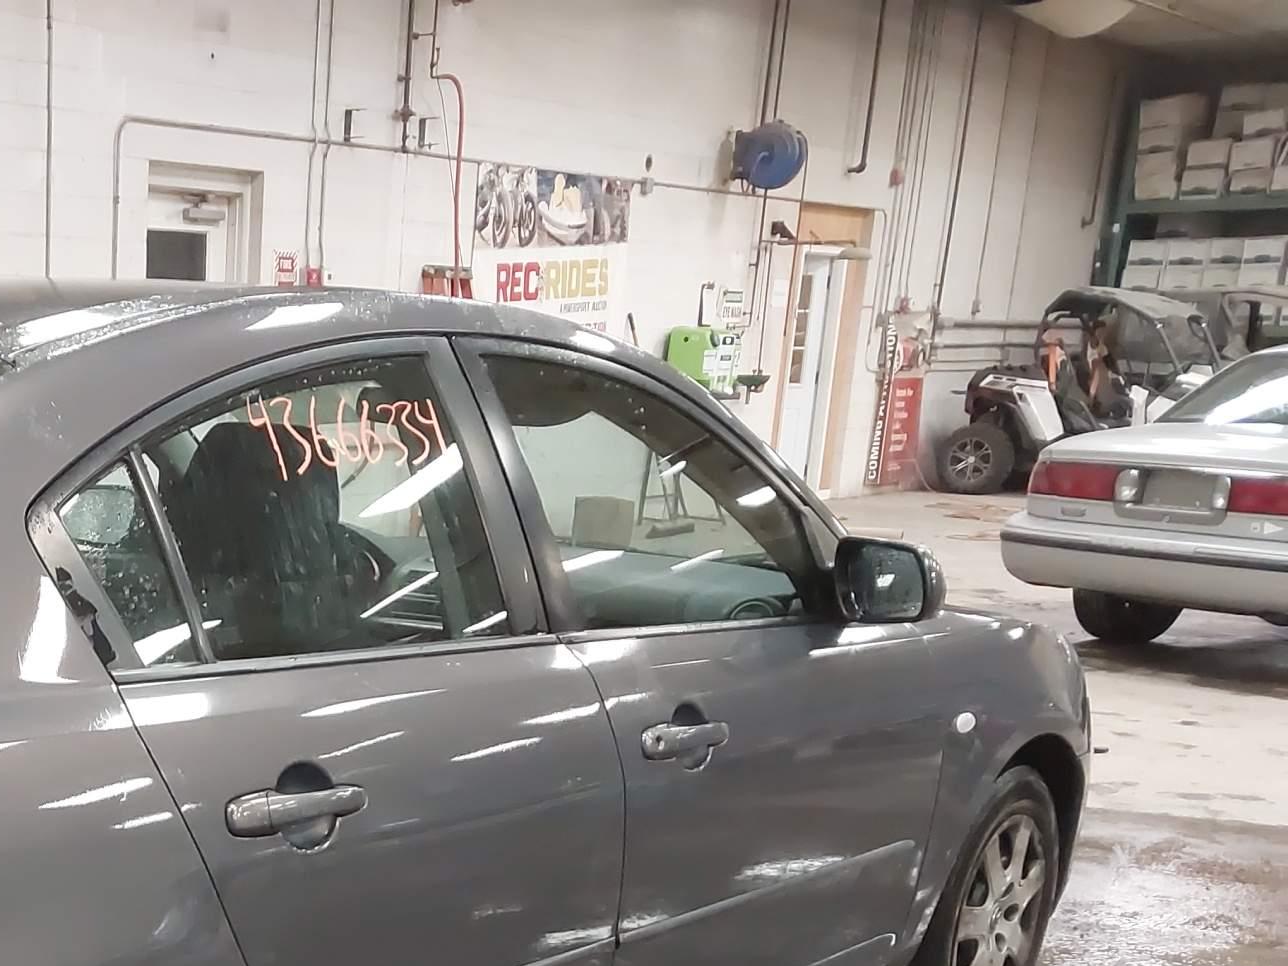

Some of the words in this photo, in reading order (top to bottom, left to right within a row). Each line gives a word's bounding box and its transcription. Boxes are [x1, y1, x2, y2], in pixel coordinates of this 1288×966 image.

[496, 262, 540, 303] REC
[545, 258, 608, 299] RIDES
[246, 394, 448, 481] 43666334
[868, 420, 884, 480] COMING
